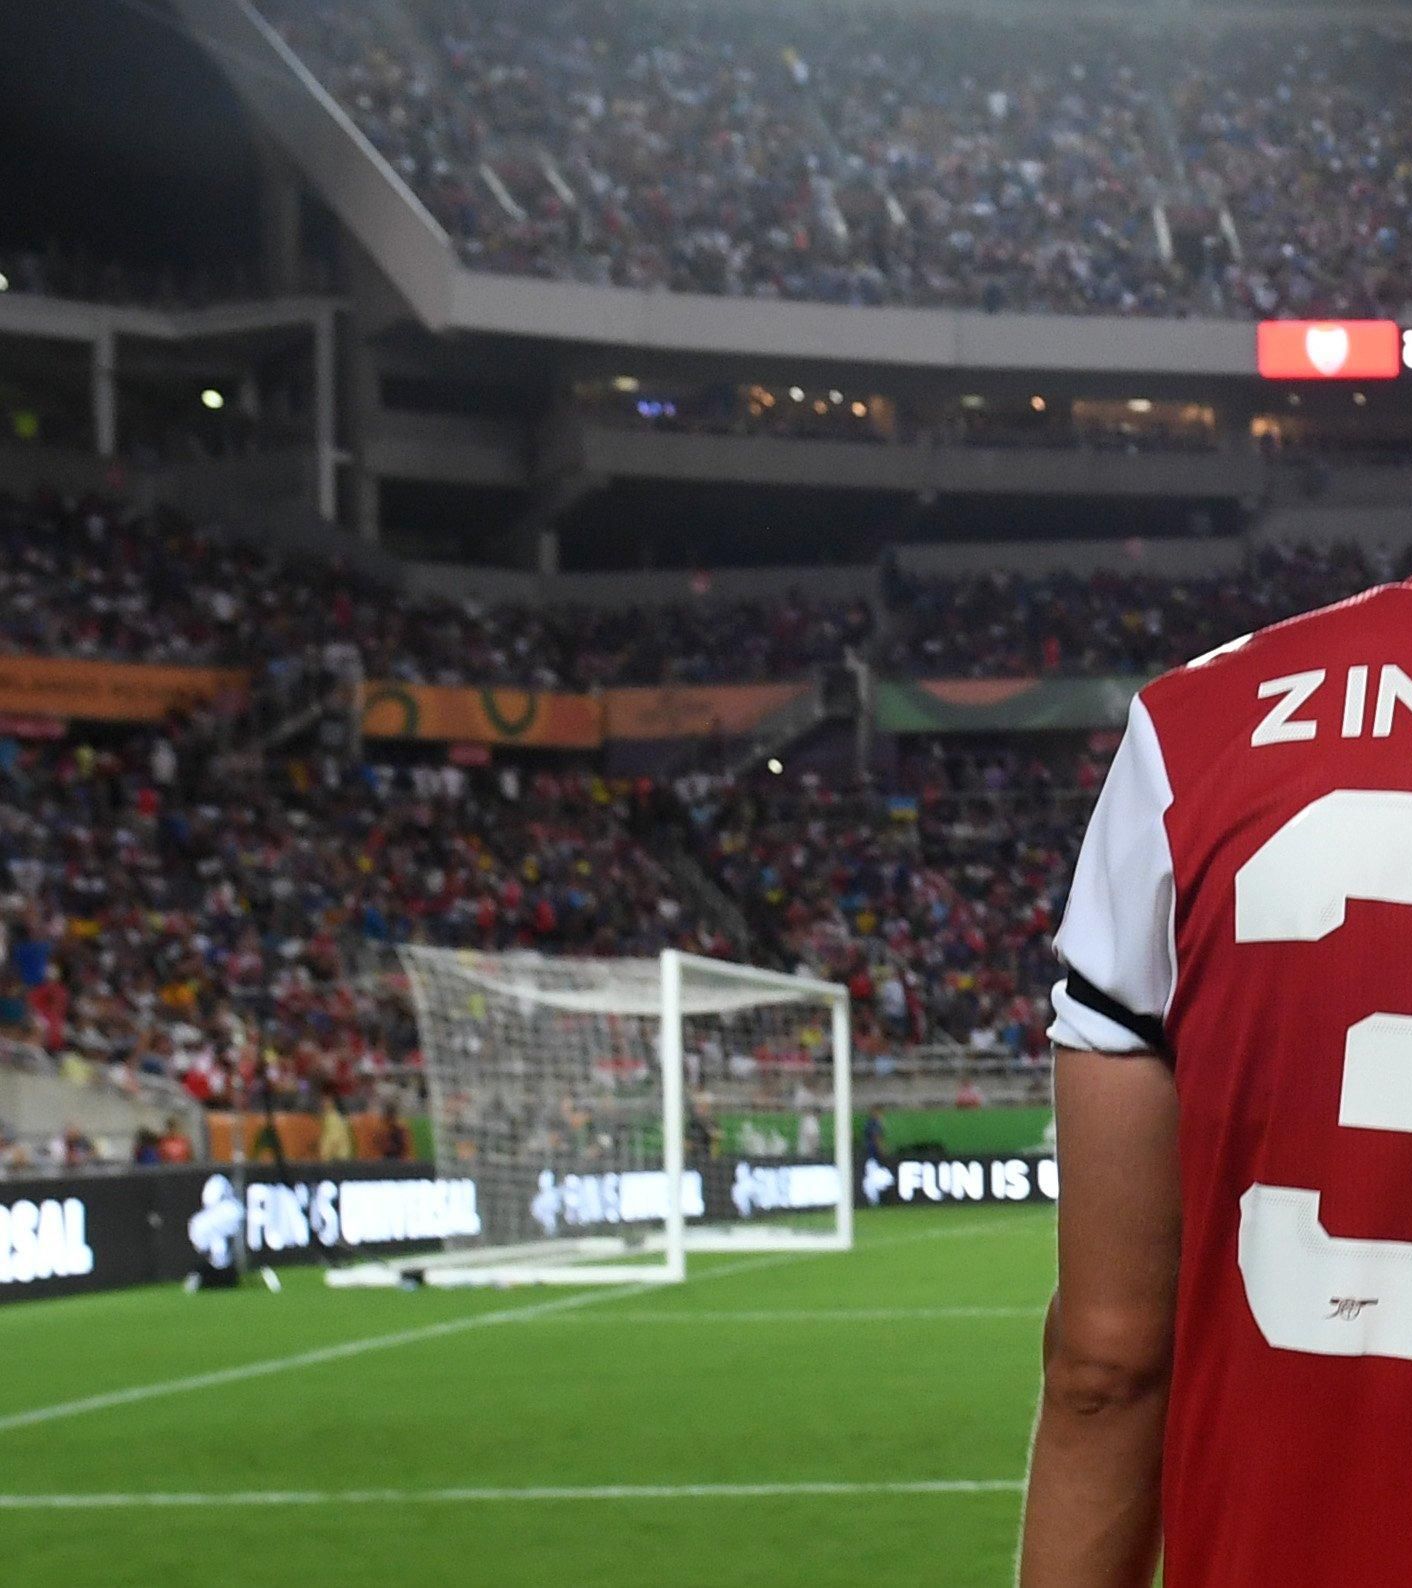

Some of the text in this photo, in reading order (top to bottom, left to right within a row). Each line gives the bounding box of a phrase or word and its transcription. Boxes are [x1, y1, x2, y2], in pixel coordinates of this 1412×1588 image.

[898, 1159, 984, 1201] FUN
[991, 1158, 1031, 1200] IS
[0, 1197, 94, 1284] SAL
